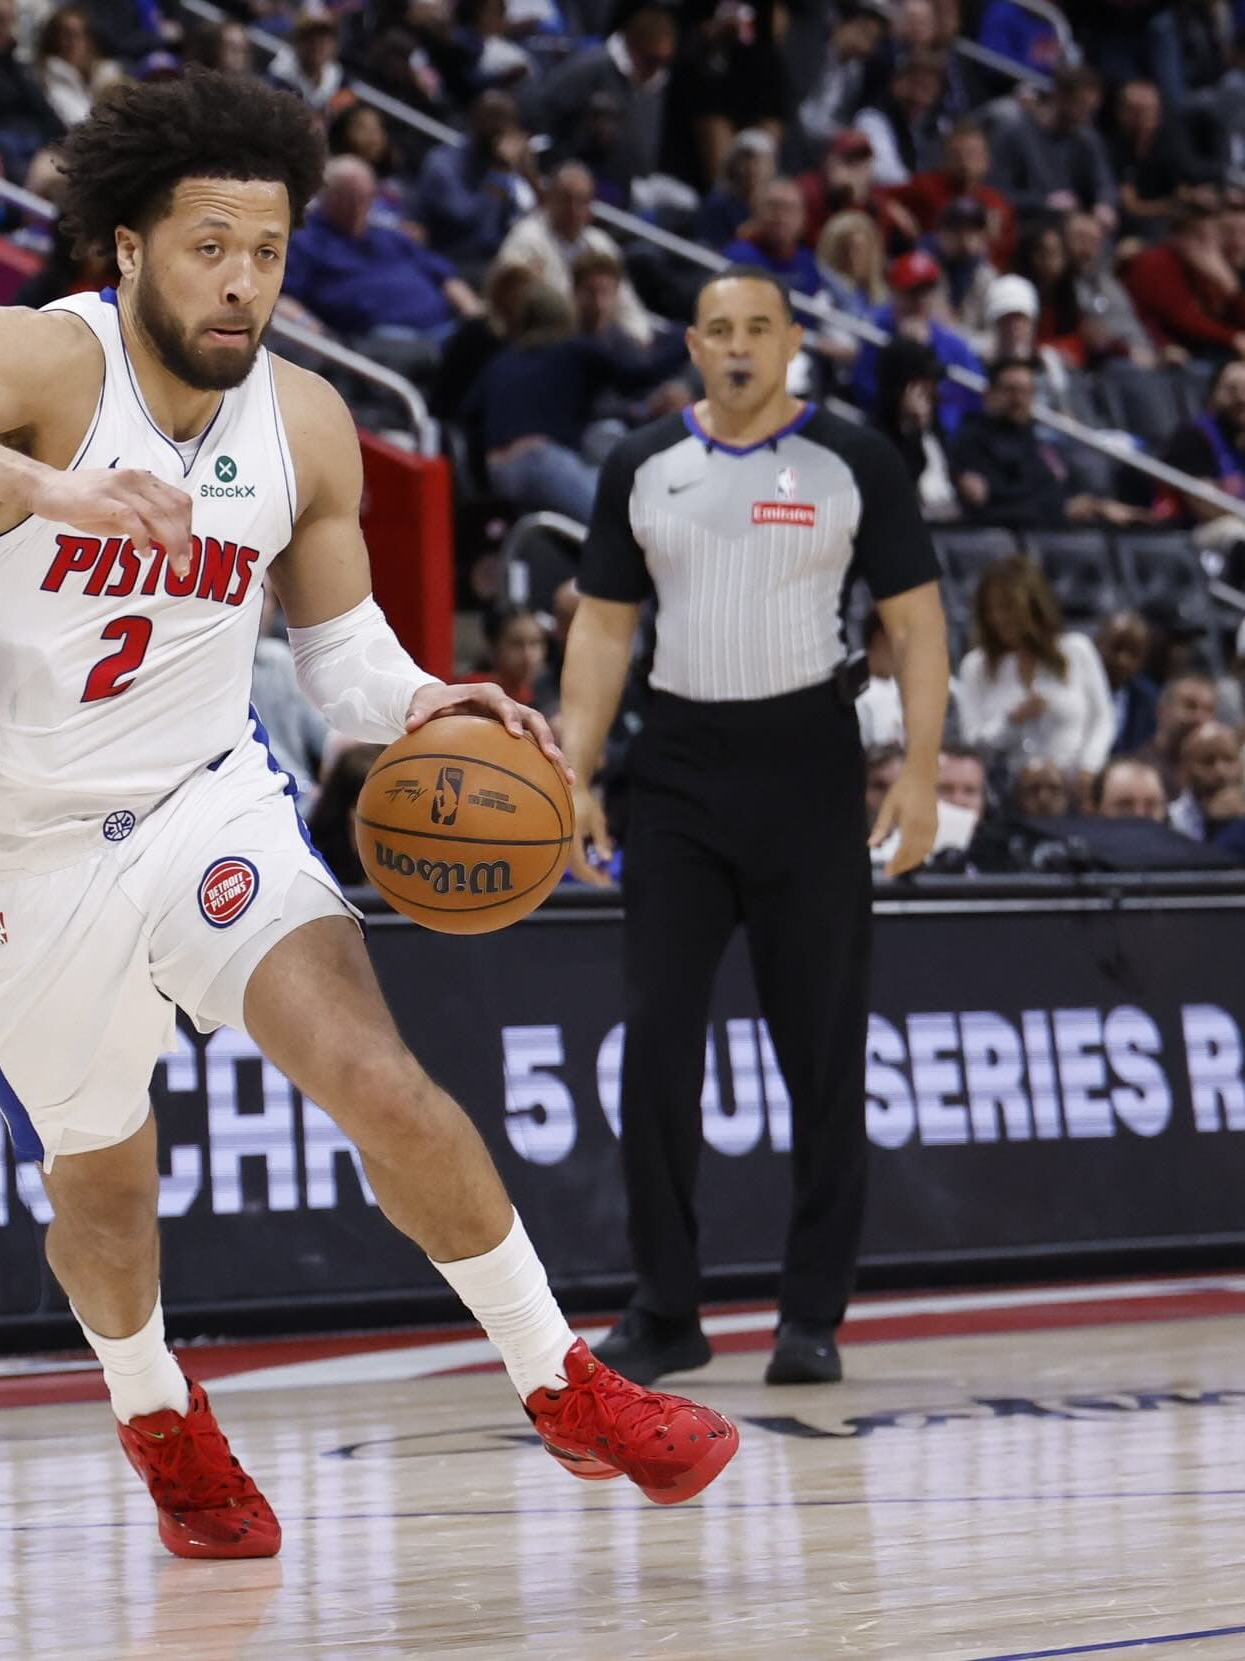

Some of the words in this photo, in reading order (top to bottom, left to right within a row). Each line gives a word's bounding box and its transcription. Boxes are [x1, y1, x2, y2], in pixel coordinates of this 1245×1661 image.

[200, 484, 256, 498] StockX
[754, 504, 814, 521] Emirates
[40, 533, 260, 607] PISTONS
[79, 614, 154, 704] 2
[207, 871, 244, 901] DETROIT
[375, 840, 514, 895] Wilson
[210, 881, 247, 912] PISTONS
[501, 1024, 578, 1166] 5
[864, 1004, 1173, 1150] SERIES
